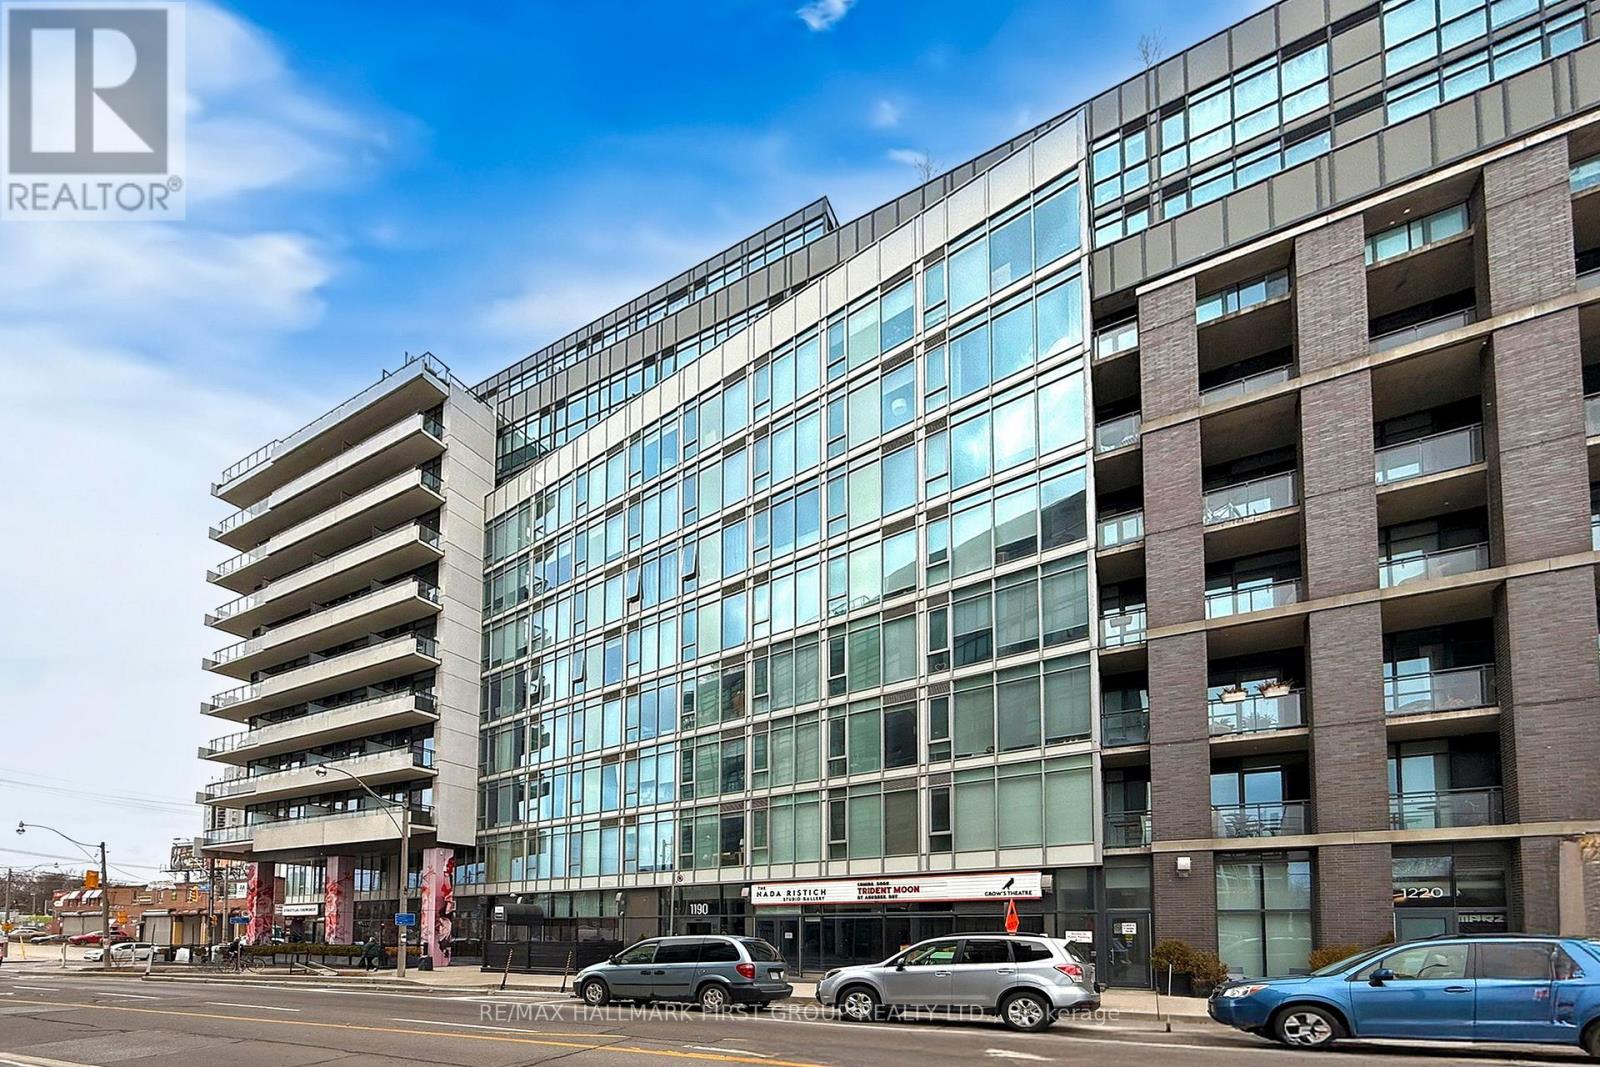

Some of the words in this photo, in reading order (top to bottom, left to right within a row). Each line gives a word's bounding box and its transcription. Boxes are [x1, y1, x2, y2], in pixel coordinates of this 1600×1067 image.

[756, 890, 782, 898] NADA
[786, 888, 827, 897] RISTICH
[857, 886, 892, 895] TRIDENT
[893, 885, 920, 894] MOON
[1400, 887, 1444, 899] 1220
[690, 903, 709, 915] 1190
